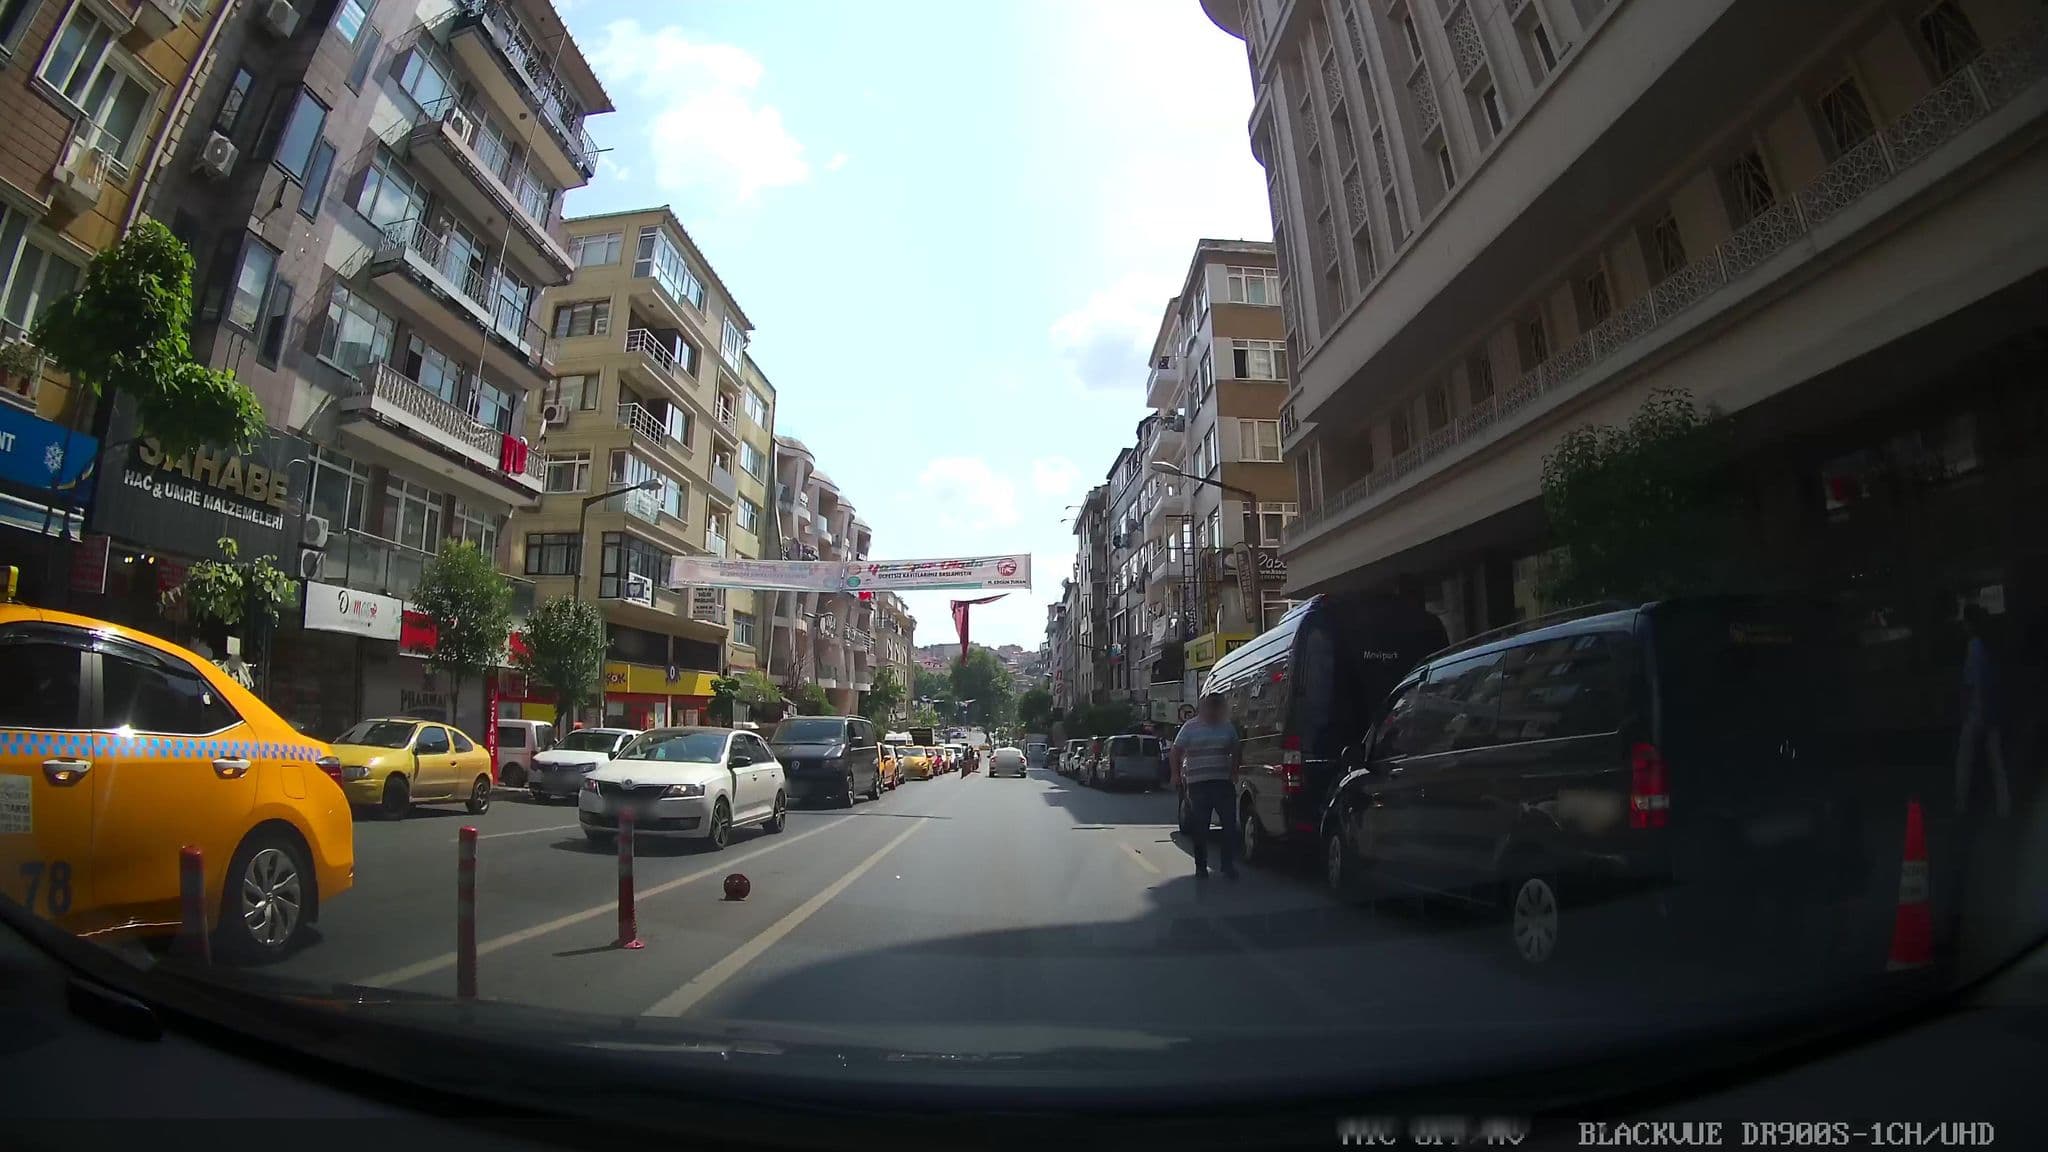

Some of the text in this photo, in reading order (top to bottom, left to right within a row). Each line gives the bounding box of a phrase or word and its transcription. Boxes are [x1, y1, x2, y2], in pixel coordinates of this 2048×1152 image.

[124, 469, 153, 491] HAC
[165, 481, 201, 507] UMRE
[203, 494, 285, 531] MALZEMELERİ
